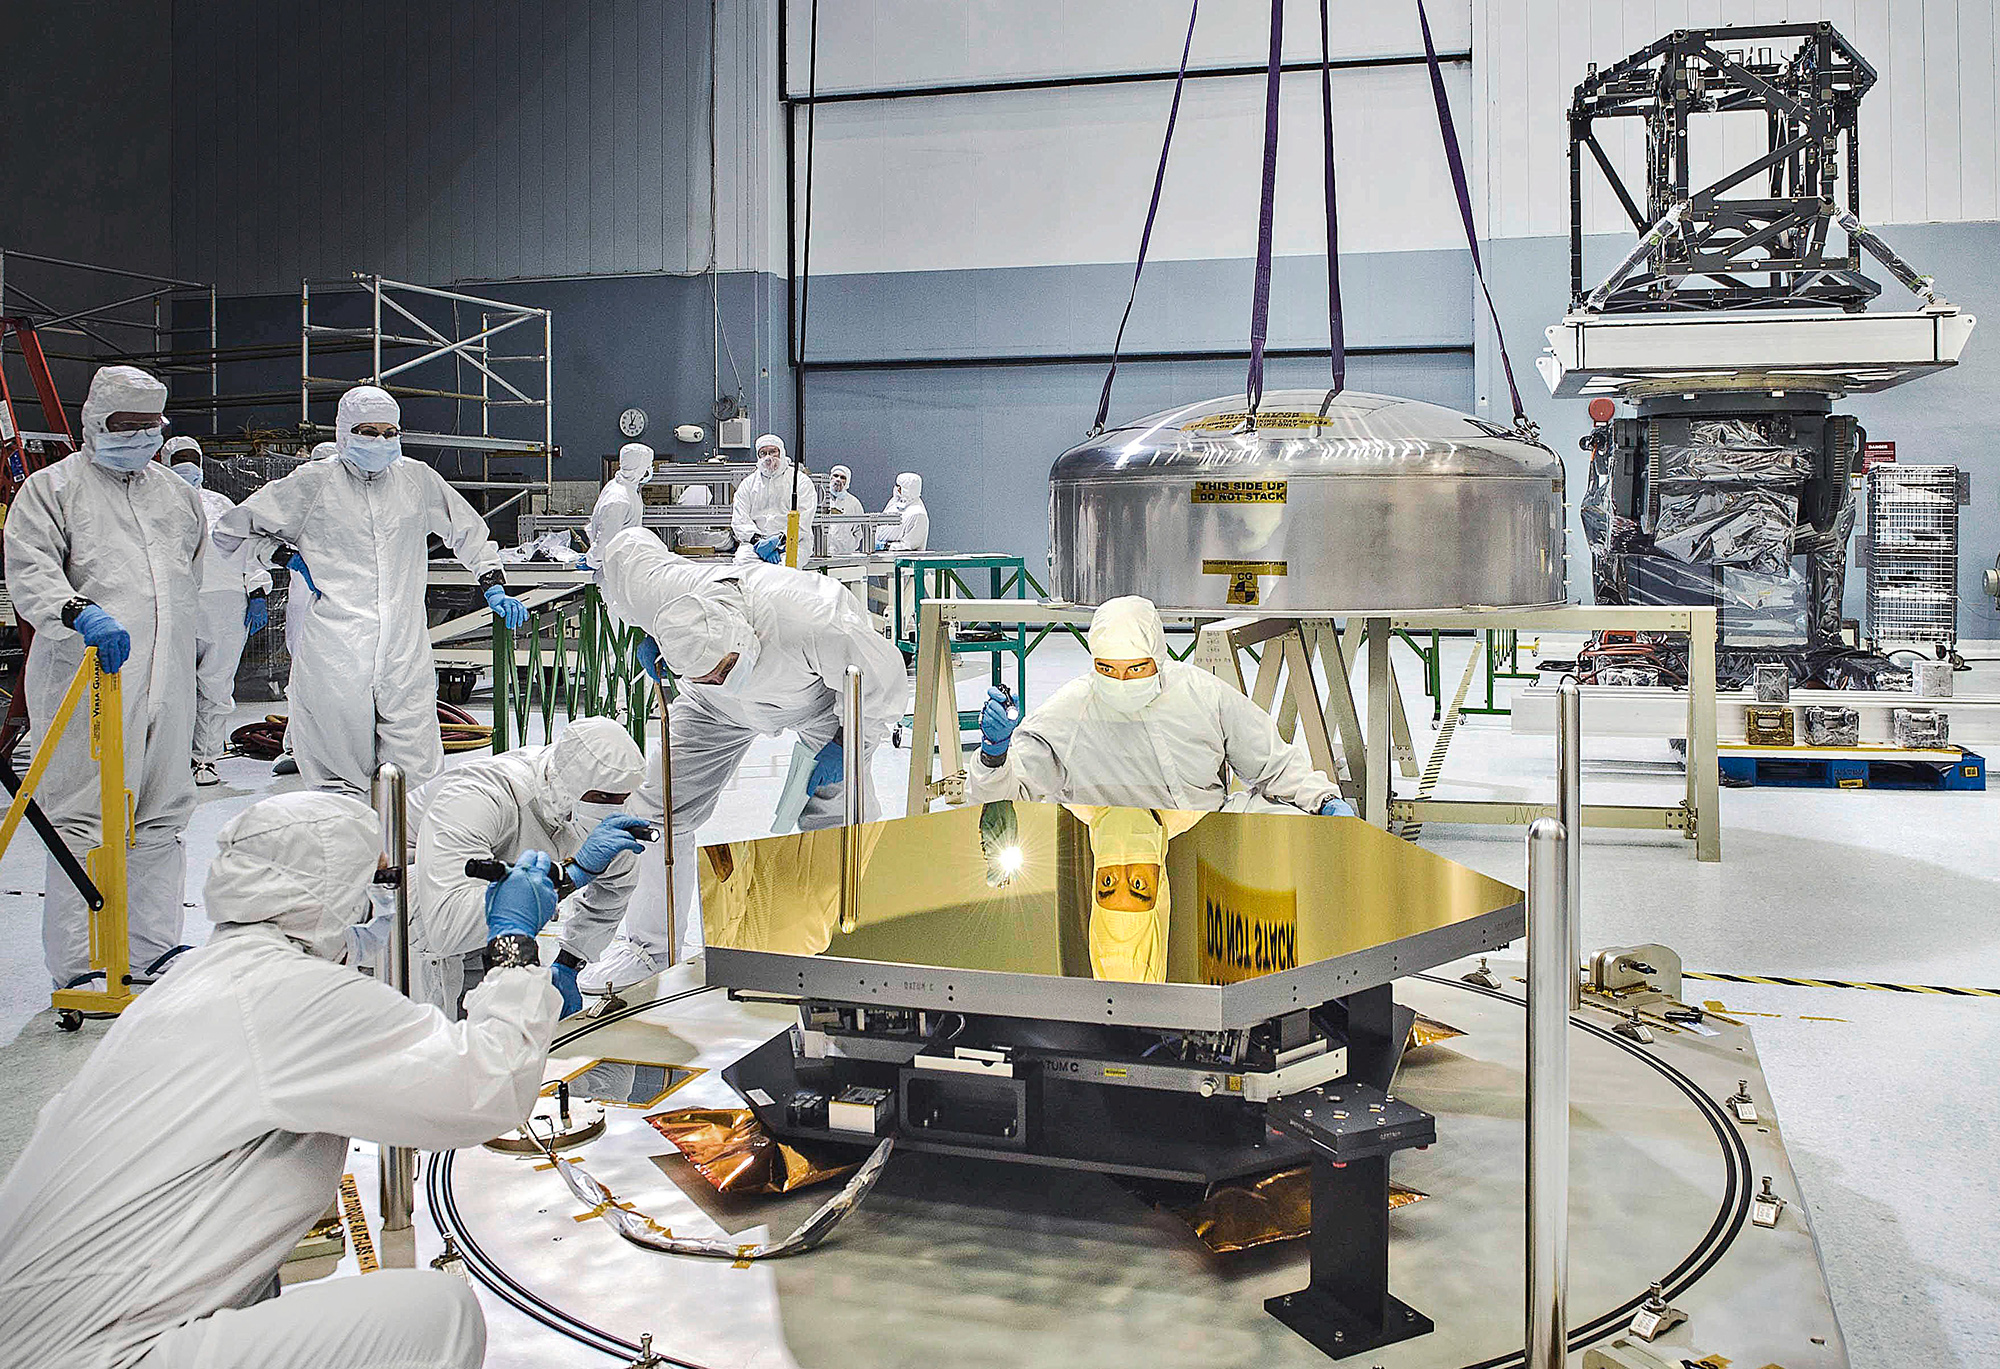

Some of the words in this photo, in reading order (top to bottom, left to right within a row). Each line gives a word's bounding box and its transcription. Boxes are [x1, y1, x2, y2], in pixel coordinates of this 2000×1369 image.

[1200, 482, 1229, 491] THIS
[1234, 482, 1263, 491] SIDE
[1267, 482, 1285, 491] UP
[1200, 492, 1216, 501] DO
[1219, 492, 1243, 501] NOT
[1245, 491, 1284, 501] STACK
[1237, 572, 1253, 581] CG
[1071, 1062, 1079, 1073] C
